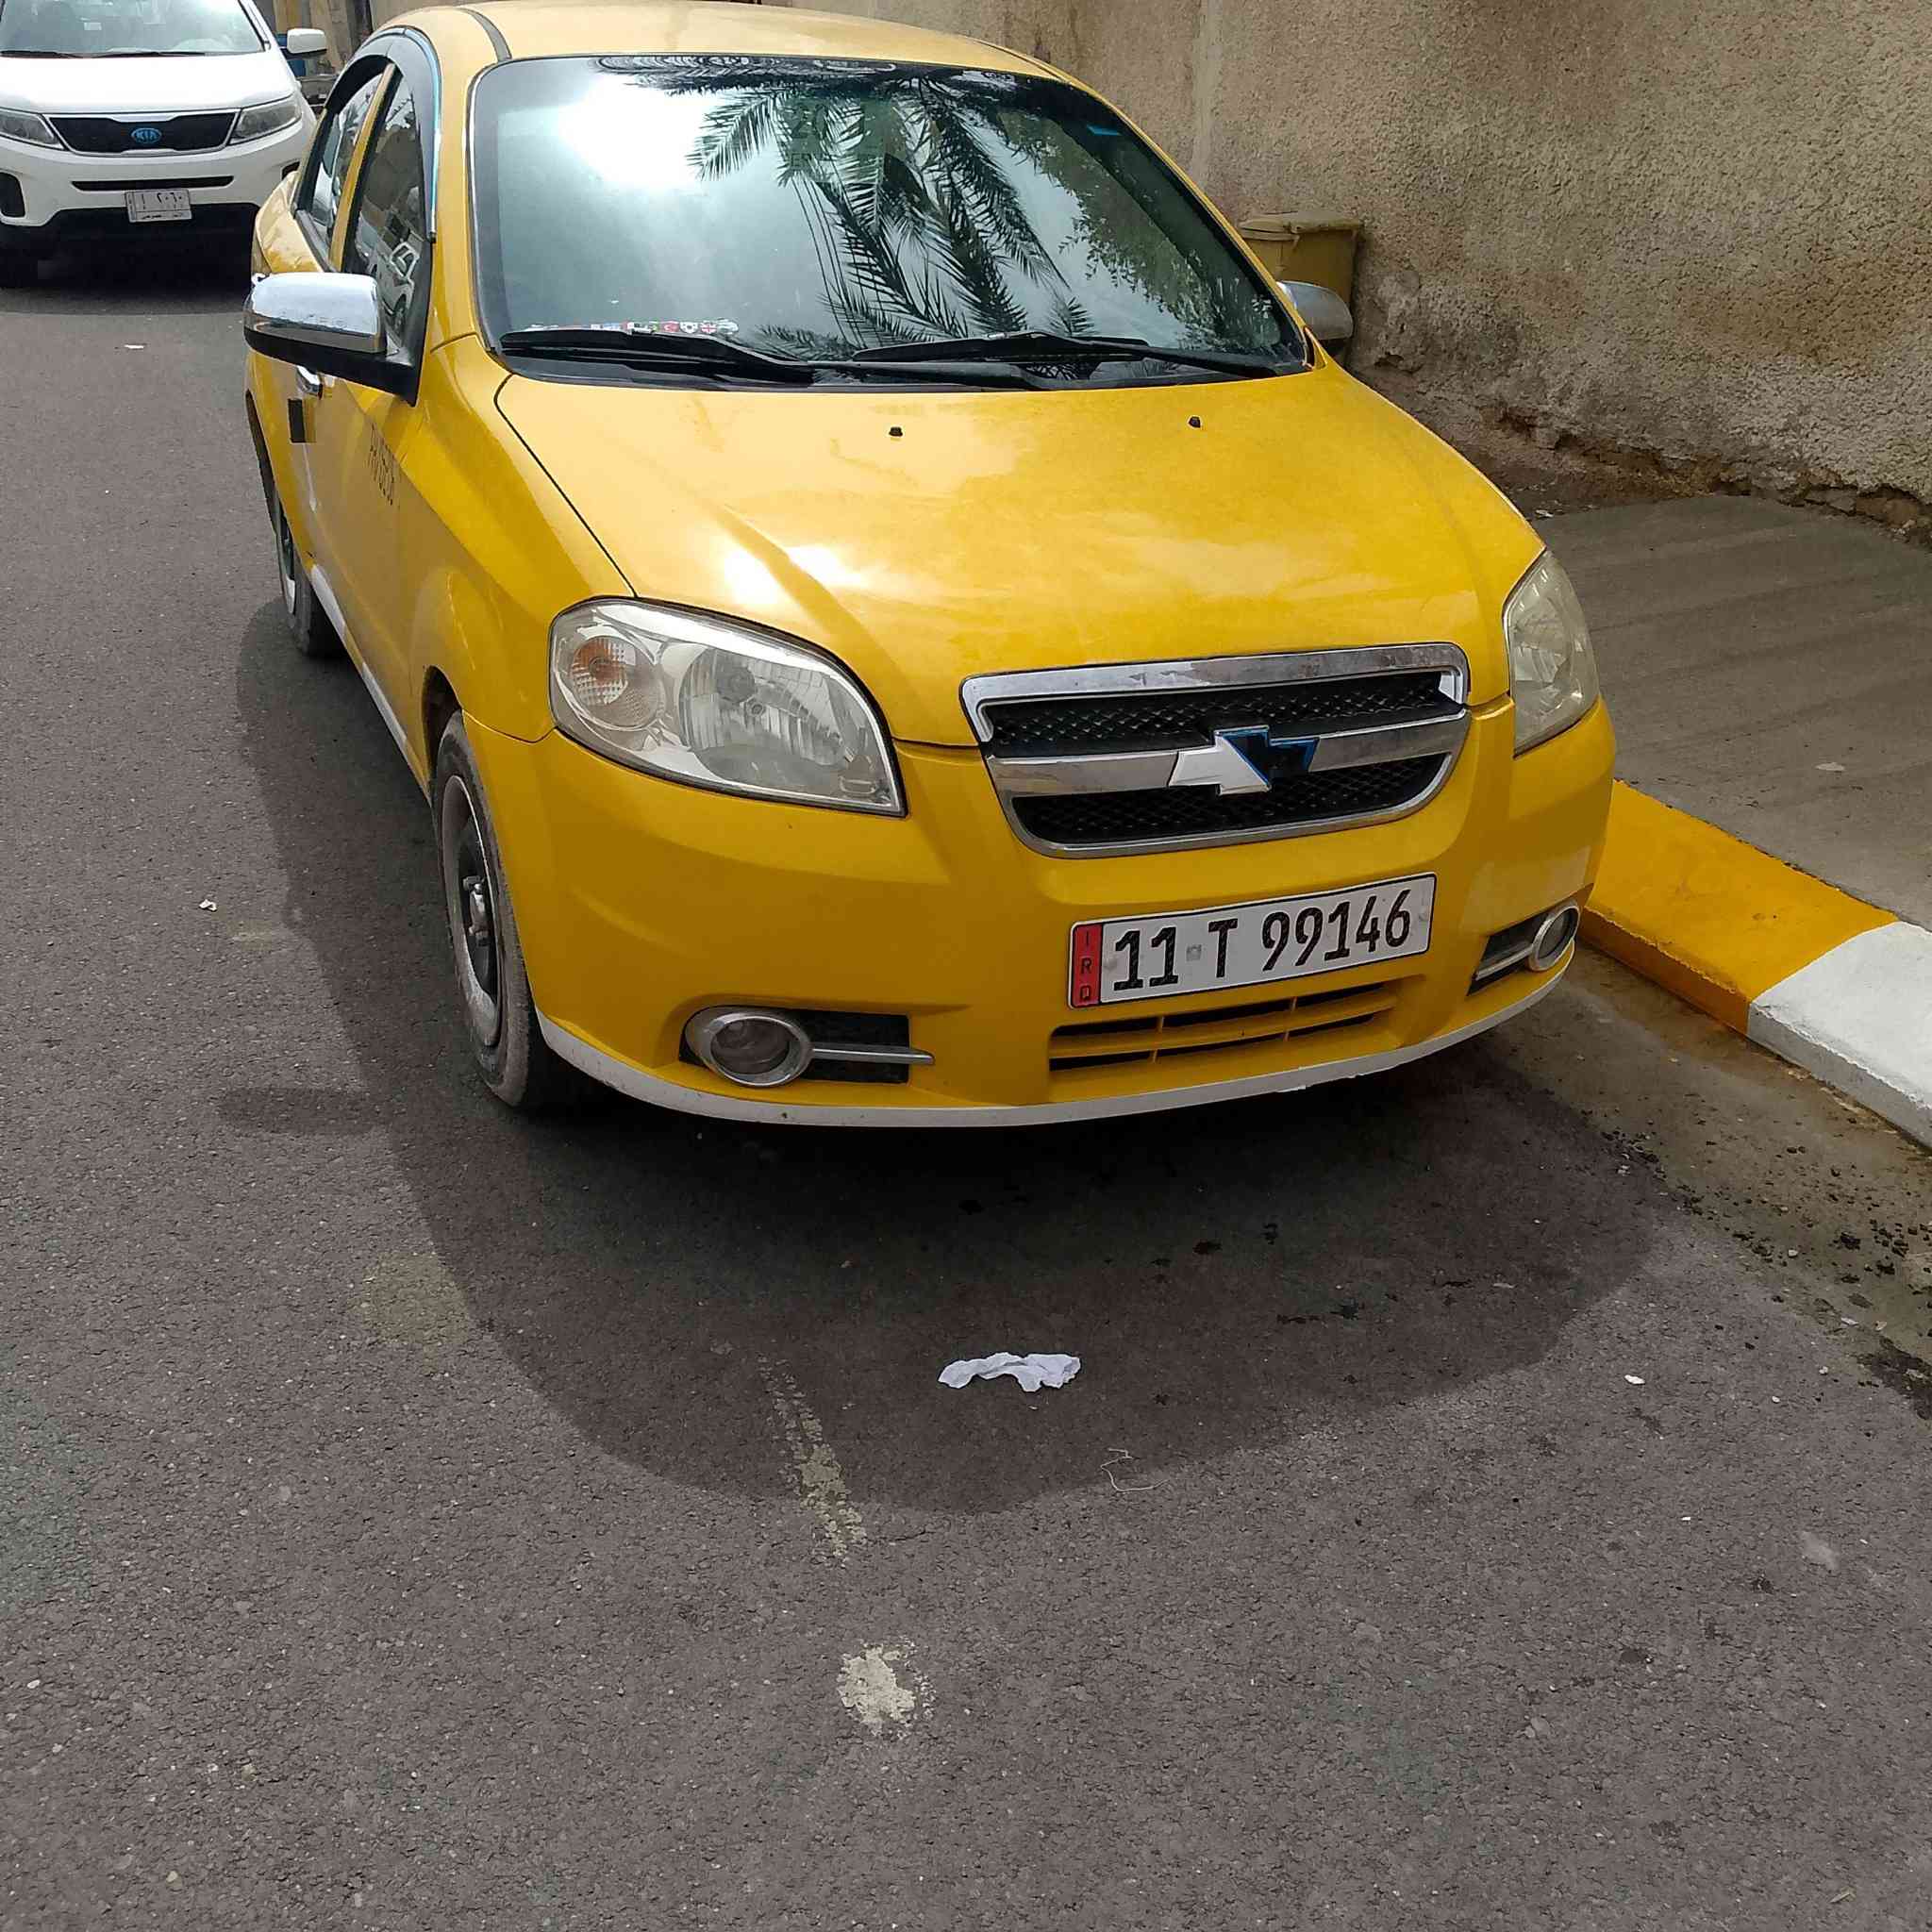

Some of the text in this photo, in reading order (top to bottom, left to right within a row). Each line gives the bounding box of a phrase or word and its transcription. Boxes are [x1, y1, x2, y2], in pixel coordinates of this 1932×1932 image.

[1112, 889, 1413, 991] 11 T 99146
